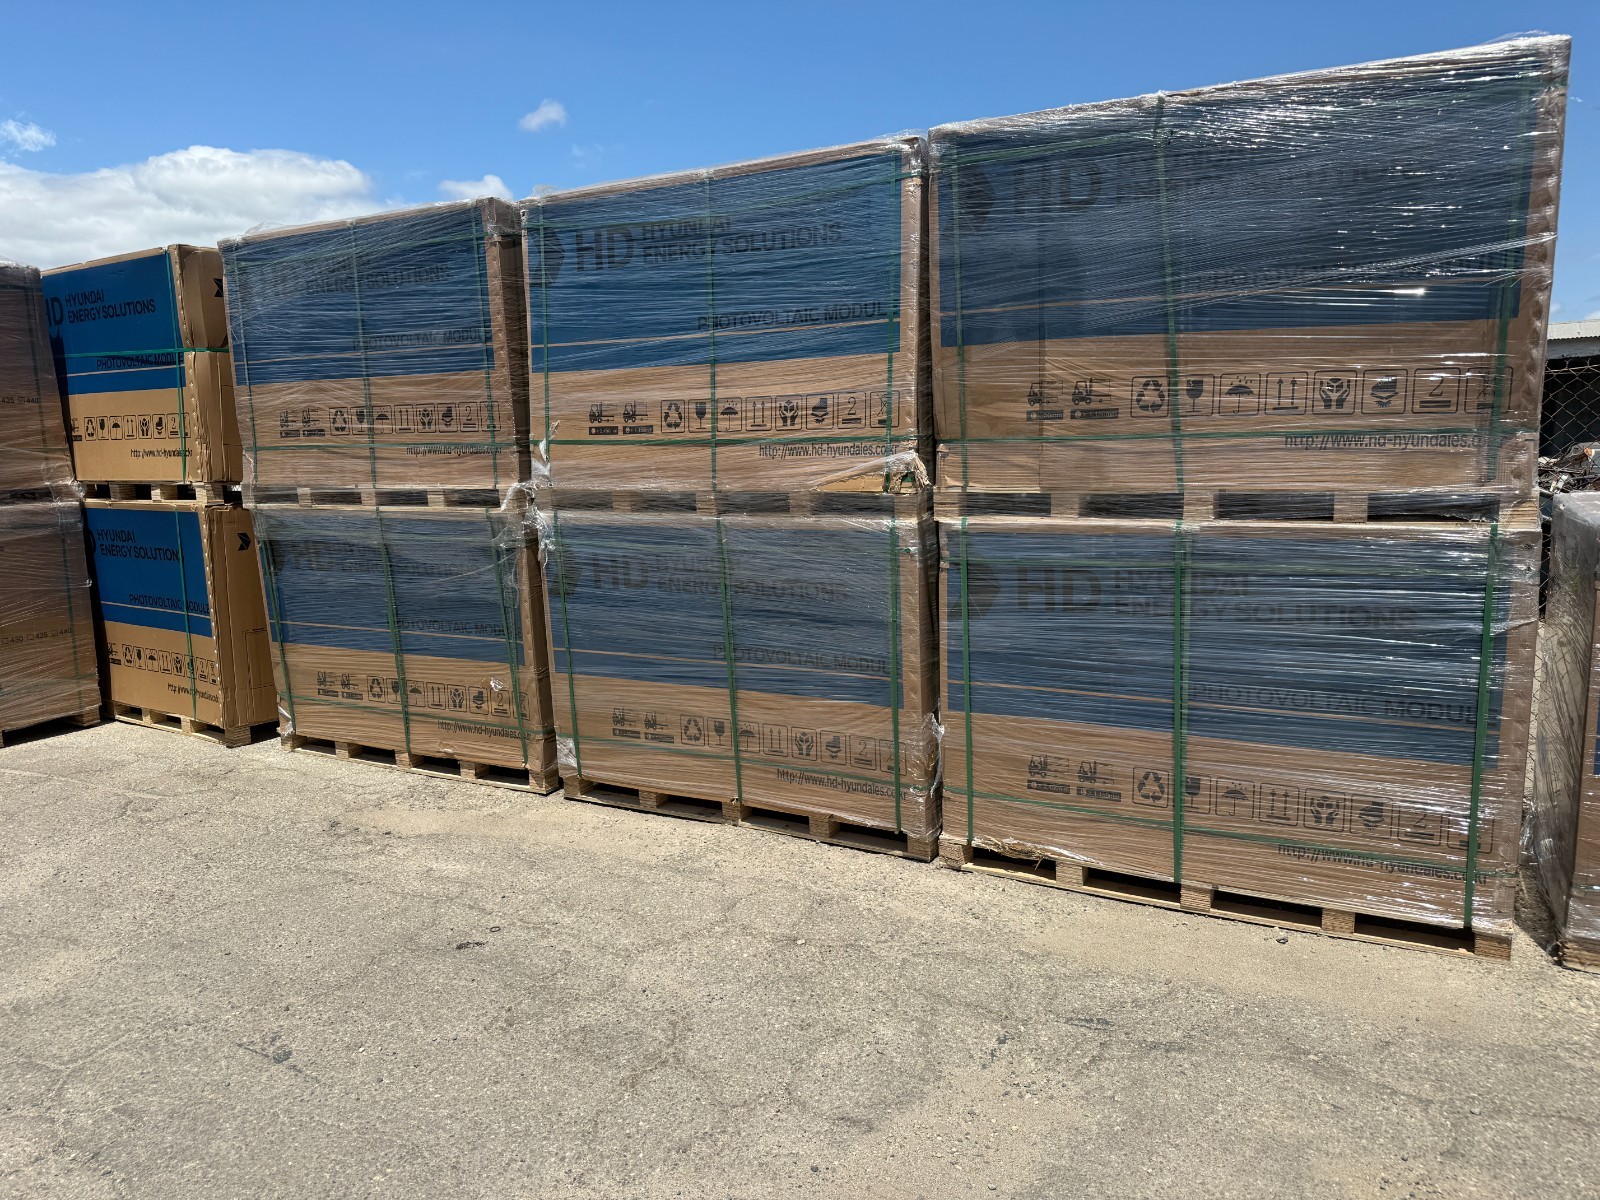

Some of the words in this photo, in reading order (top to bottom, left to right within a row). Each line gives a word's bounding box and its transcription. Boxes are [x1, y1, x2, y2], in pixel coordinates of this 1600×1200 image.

[575, 227, 634, 272] HD
[722, 223, 842, 255] SOLUTIONS
[64, 288, 105, 308] HYUNDAI
[67, 307, 100, 324] ENERGY
[101, 299, 156, 320] SOLUTIONS
[824, 299, 898, 321] MODUL
[96, 354, 152, 370] PHOTOVOLTAIC
[154, 351, 184, 365] MODUE
[759, 442, 900, 460] http://www.hd-hyundaies.cokr
[96, 528, 137, 544] HYUNDAI
[100, 543, 132, 558] ENERGY
[1016, 566, 1101, 612] HD
[1114, 569, 1249, 597] HYUDAI
[184, 599, 210, 614] ODULE
[36, 631, 48, 639] 435
[712, 645, 832, 667] POTOVOLTAIC
[834, 654, 899, 677] MODUL
[776, 768, 908, 801] http://www.hd-hyundaies.cokr
